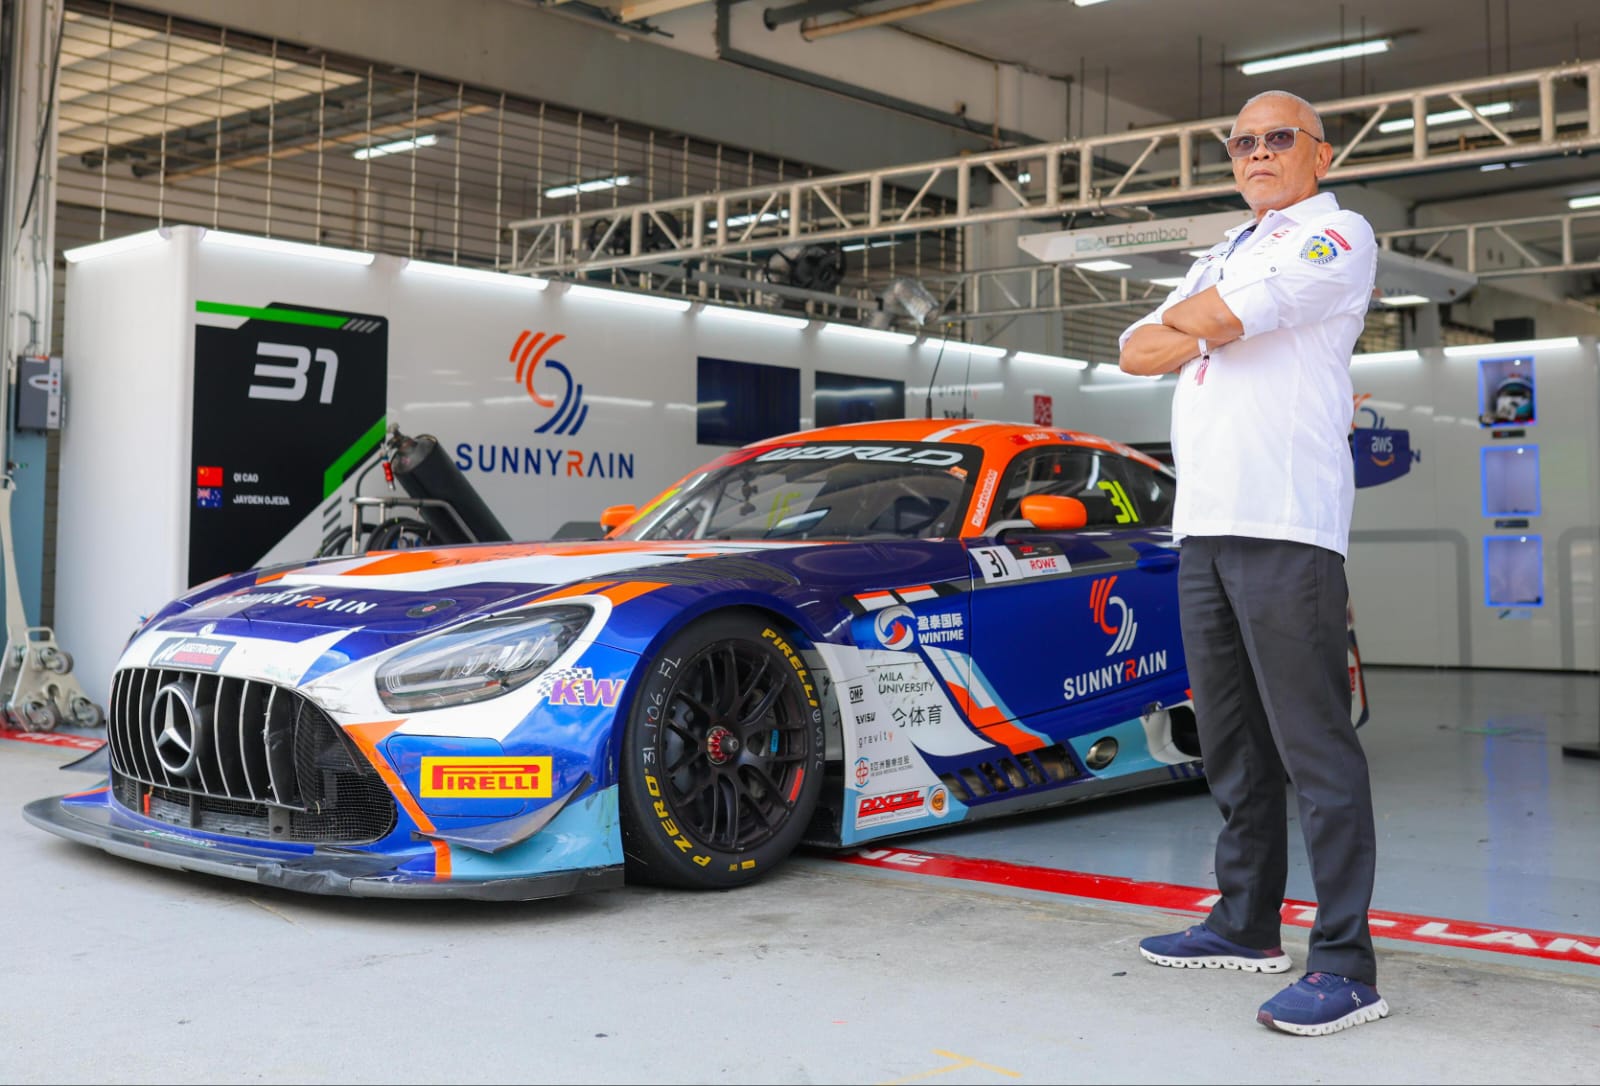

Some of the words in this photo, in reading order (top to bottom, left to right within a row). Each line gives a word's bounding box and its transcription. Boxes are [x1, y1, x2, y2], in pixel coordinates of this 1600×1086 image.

[248, 341, 339, 404] 31
[1371, 436, 1393, 453] aws
[456, 443, 634, 479] SUNNYRAIN
[234, 473, 242, 483] QI
[244, 473, 259, 484] CAO
[233, 494, 263, 506] JAYDEN
[265, 495, 290, 507] OJEDA
[1096, 480, 1139, 524] 31
[981, 549, 1009, 578] 31
[1030, 558, 1057, 570] ROWE
[918, 629, 964, 645] WINTIME
[762, 628, 818, 709] PIRELLI
[879, 672, 904, 682] MILA
[1063, 649, 1167, 701] SUNNYRAIN
[549, 679, 625, 707] KW
[850, 687, 864, 701] OMP
[878, 681, 935, 695] UNIVERSITY
[856, 712, 876, 725] EVISU
[858, 731, 893, 748] gravity
[432, 764, 540, 790] PIRELLI
[645, 775, 693, 853] ZERO
[857, 790, 924, 817] DIXCEL
